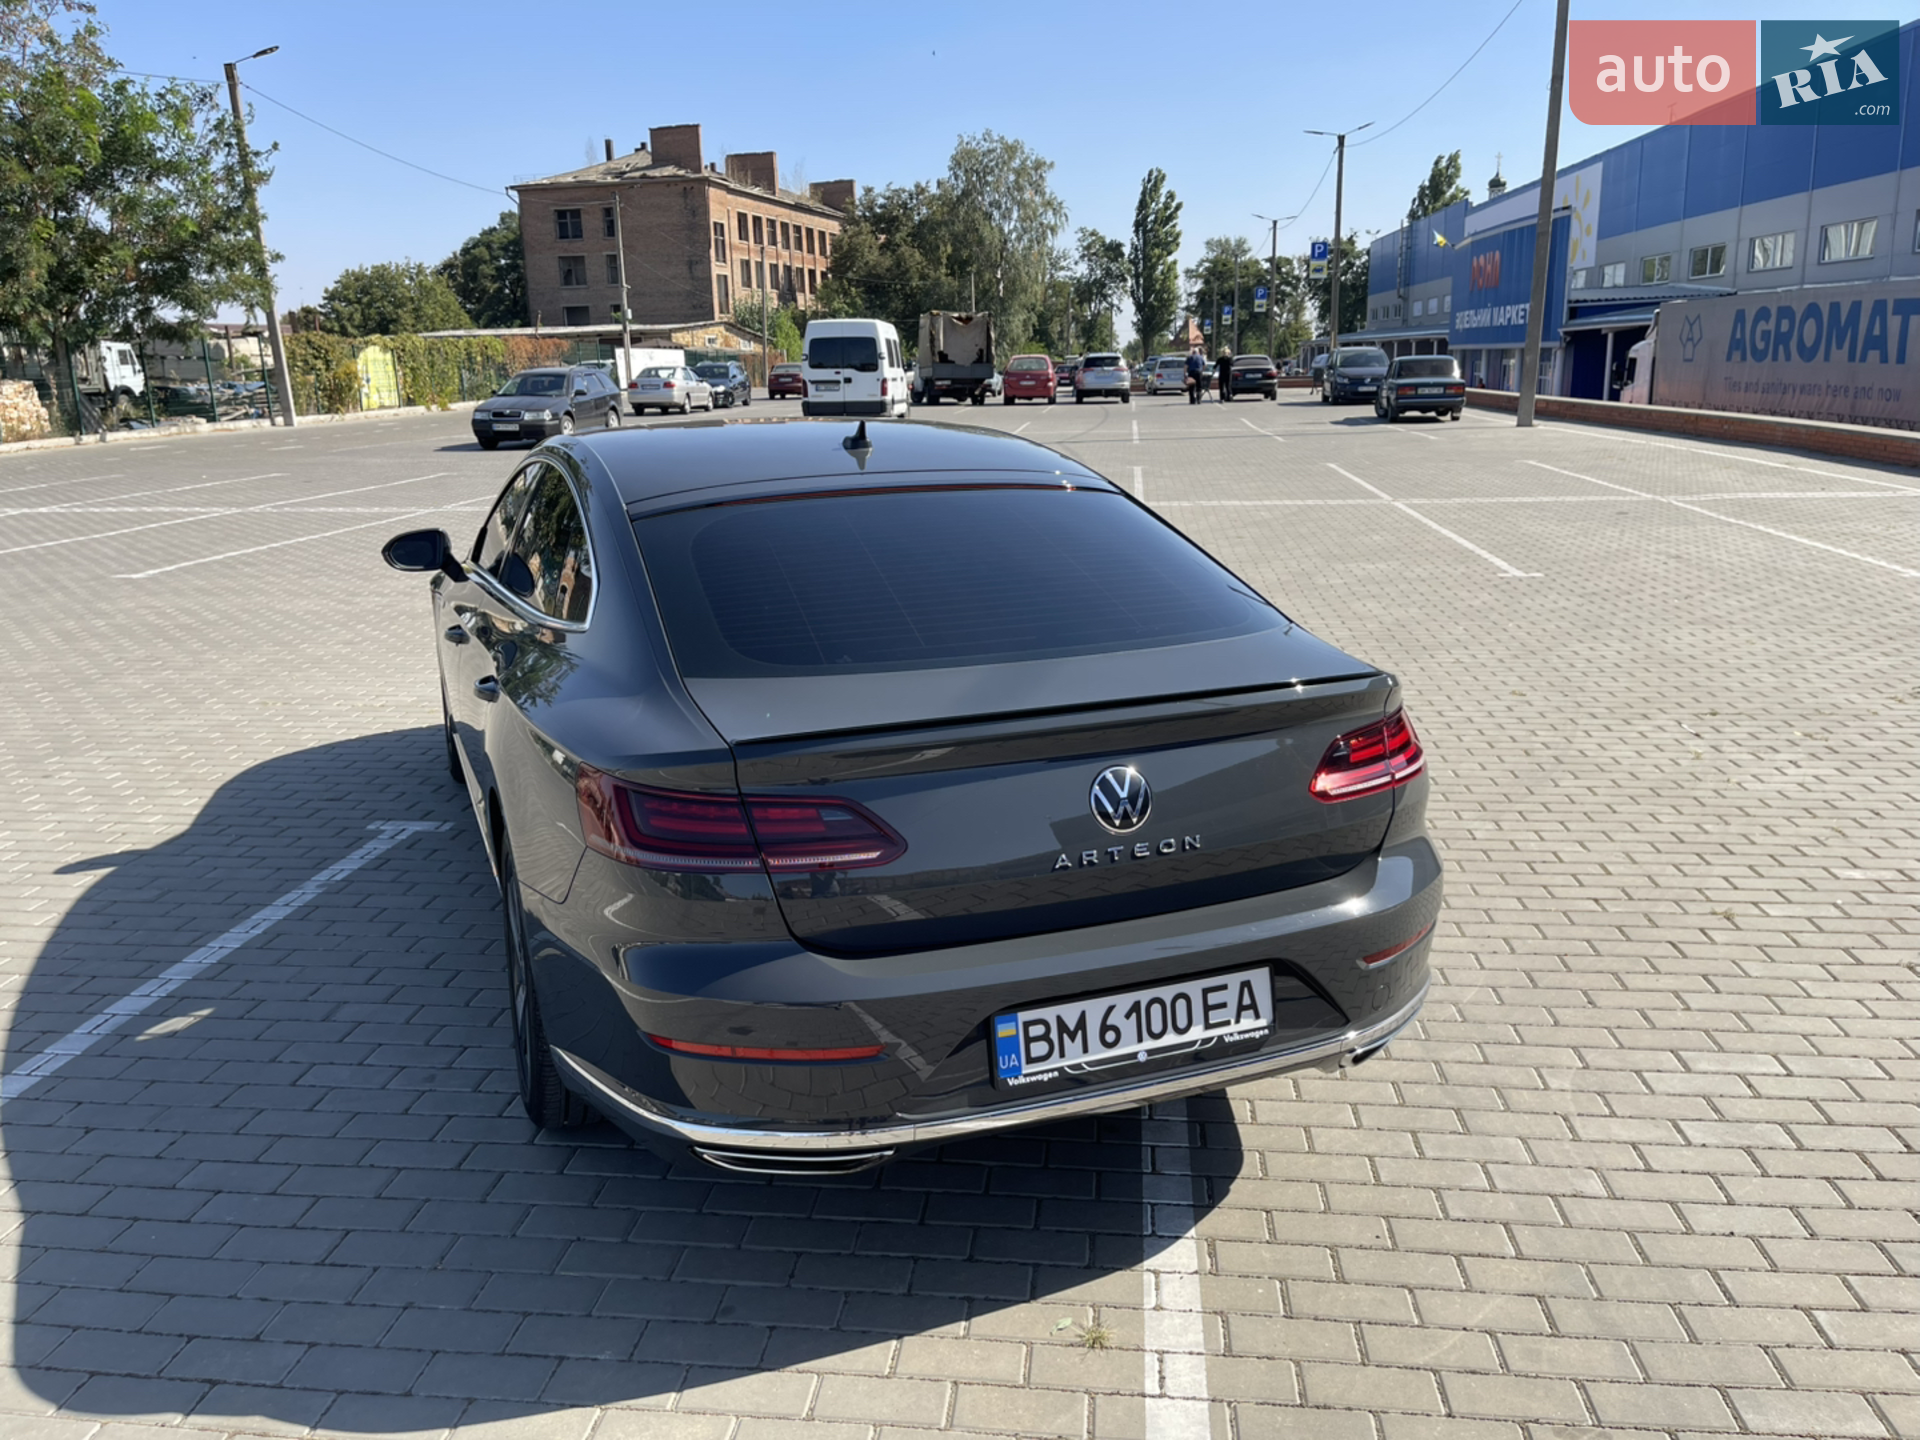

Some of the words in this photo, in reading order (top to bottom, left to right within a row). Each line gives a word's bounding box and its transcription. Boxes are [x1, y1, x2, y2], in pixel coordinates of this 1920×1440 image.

[1314, 243, 1324, 257] P
[1492, 302, 1531, 326] МАРКЕТ
[1726, 298, 1920, 365] AGROMAT
[1724, 376, 1742, 392] Tiles
[1744, 378, 1760, 393] and
[1761, 379, 1798, 399] sanitary
[1799, 383, 1822, 397] ware
[1825, 380, 1850, 399] here
[1853, 381, 1873, 401] and
[1878, 387, 1902, 402] now
[1054, 834, 1201, 869] ARTEON
[1223, 1028, 1270, 1044] Volkswagen
[999, 1052, 1019, 1070] UA
[1006, 1069, 1060, 1087] Volkswagen
